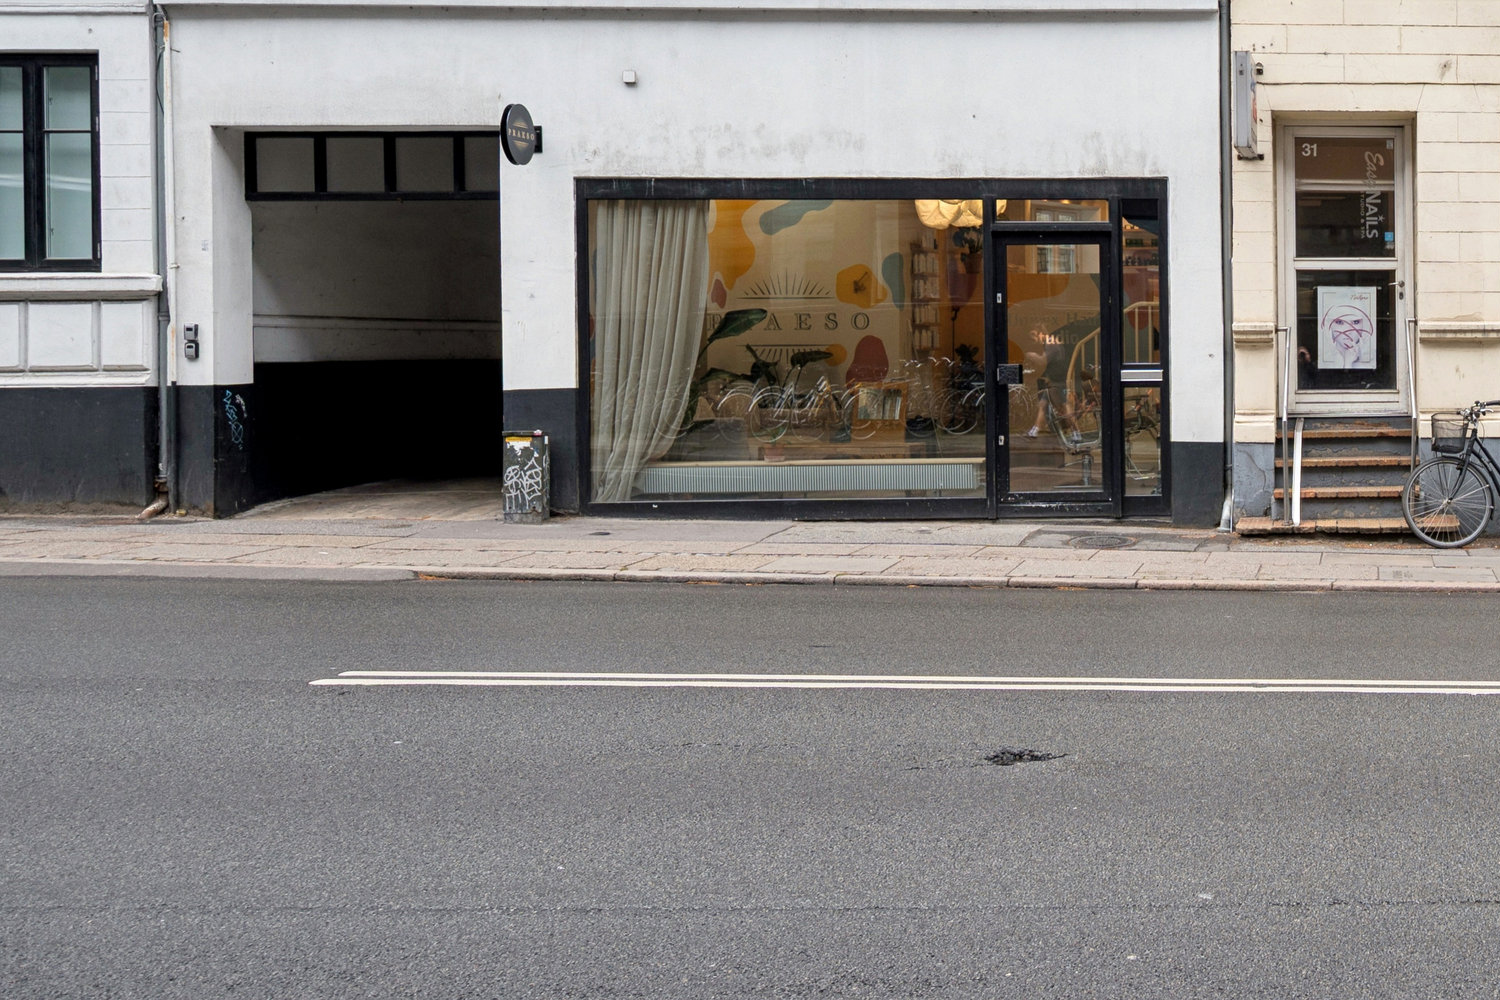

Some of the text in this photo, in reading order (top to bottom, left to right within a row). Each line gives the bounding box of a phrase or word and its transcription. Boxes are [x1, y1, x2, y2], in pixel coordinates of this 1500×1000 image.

[1301, 143, 1318, 157] 31
[1365, 190, 1383, 239] NAILS
[706, 312, 870, 331] PAESO
